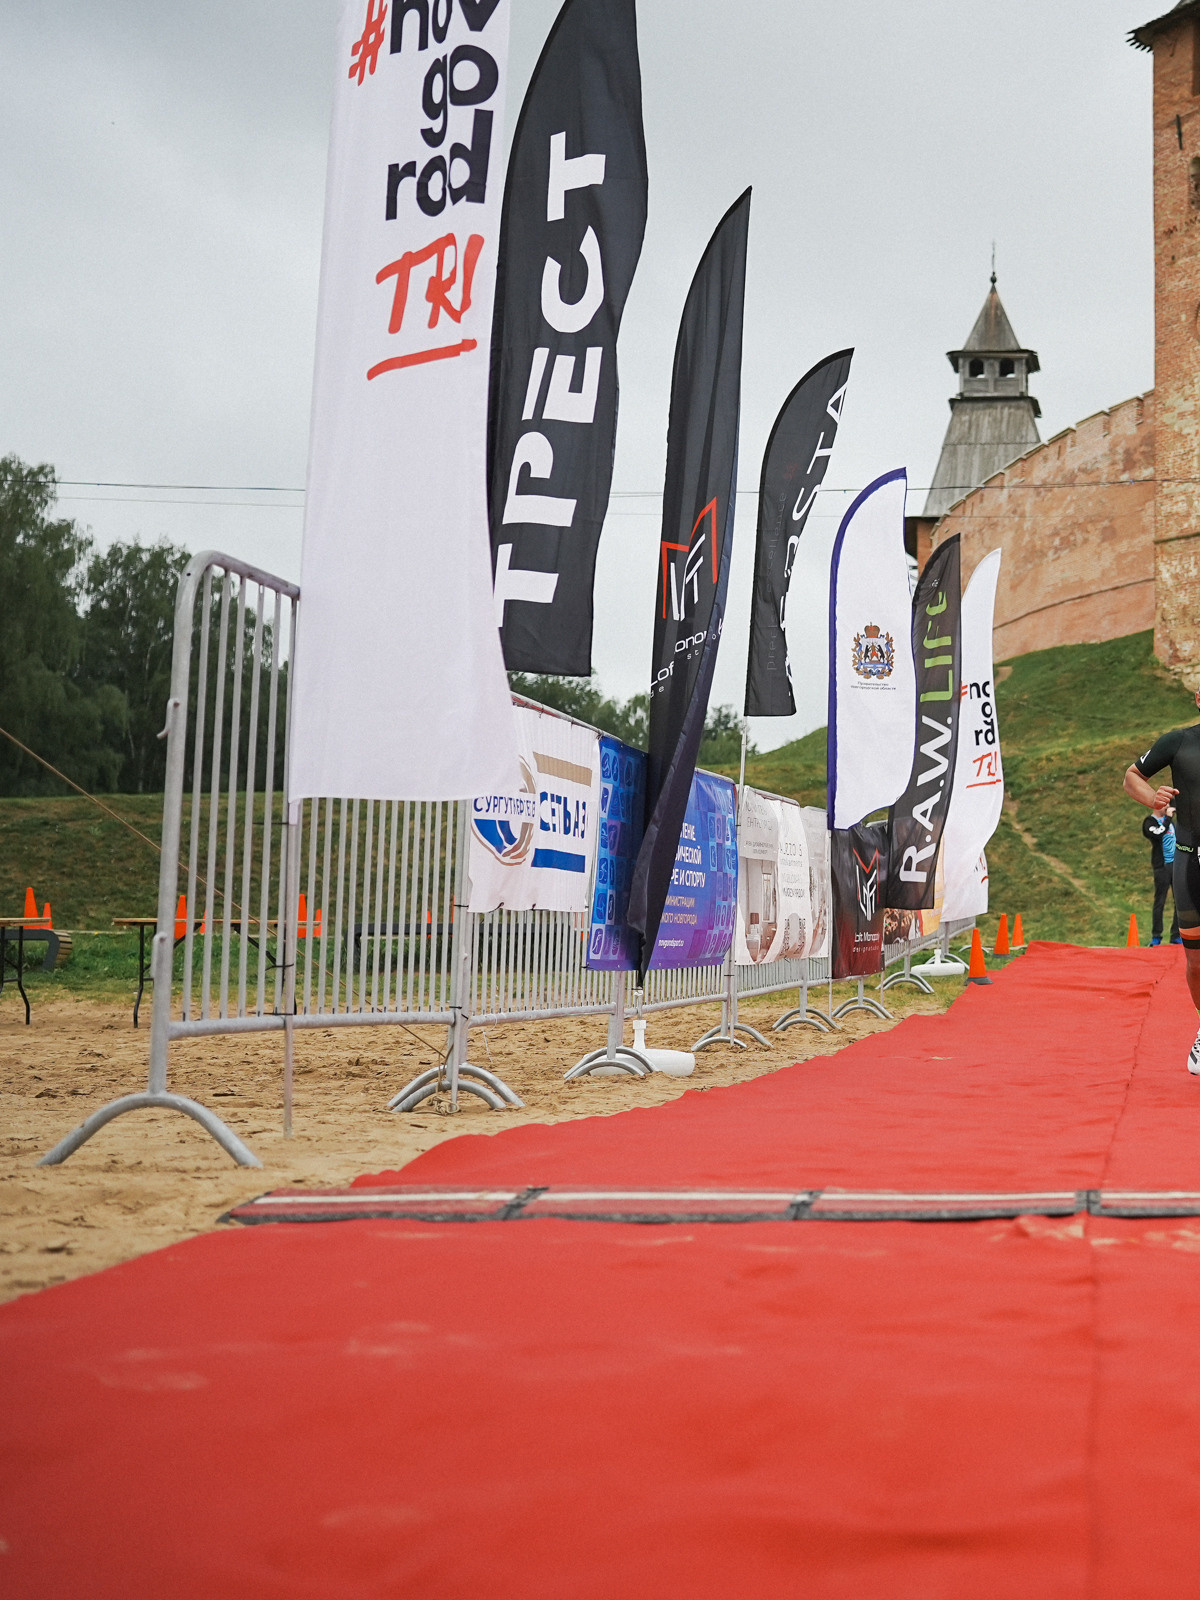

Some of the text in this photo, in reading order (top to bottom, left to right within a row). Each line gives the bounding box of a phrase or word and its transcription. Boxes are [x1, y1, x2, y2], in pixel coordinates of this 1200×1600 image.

[420, 45, 499, 148] go
[385, 109, 494, 221] rod
[376, 232, 485, 334] TRI
